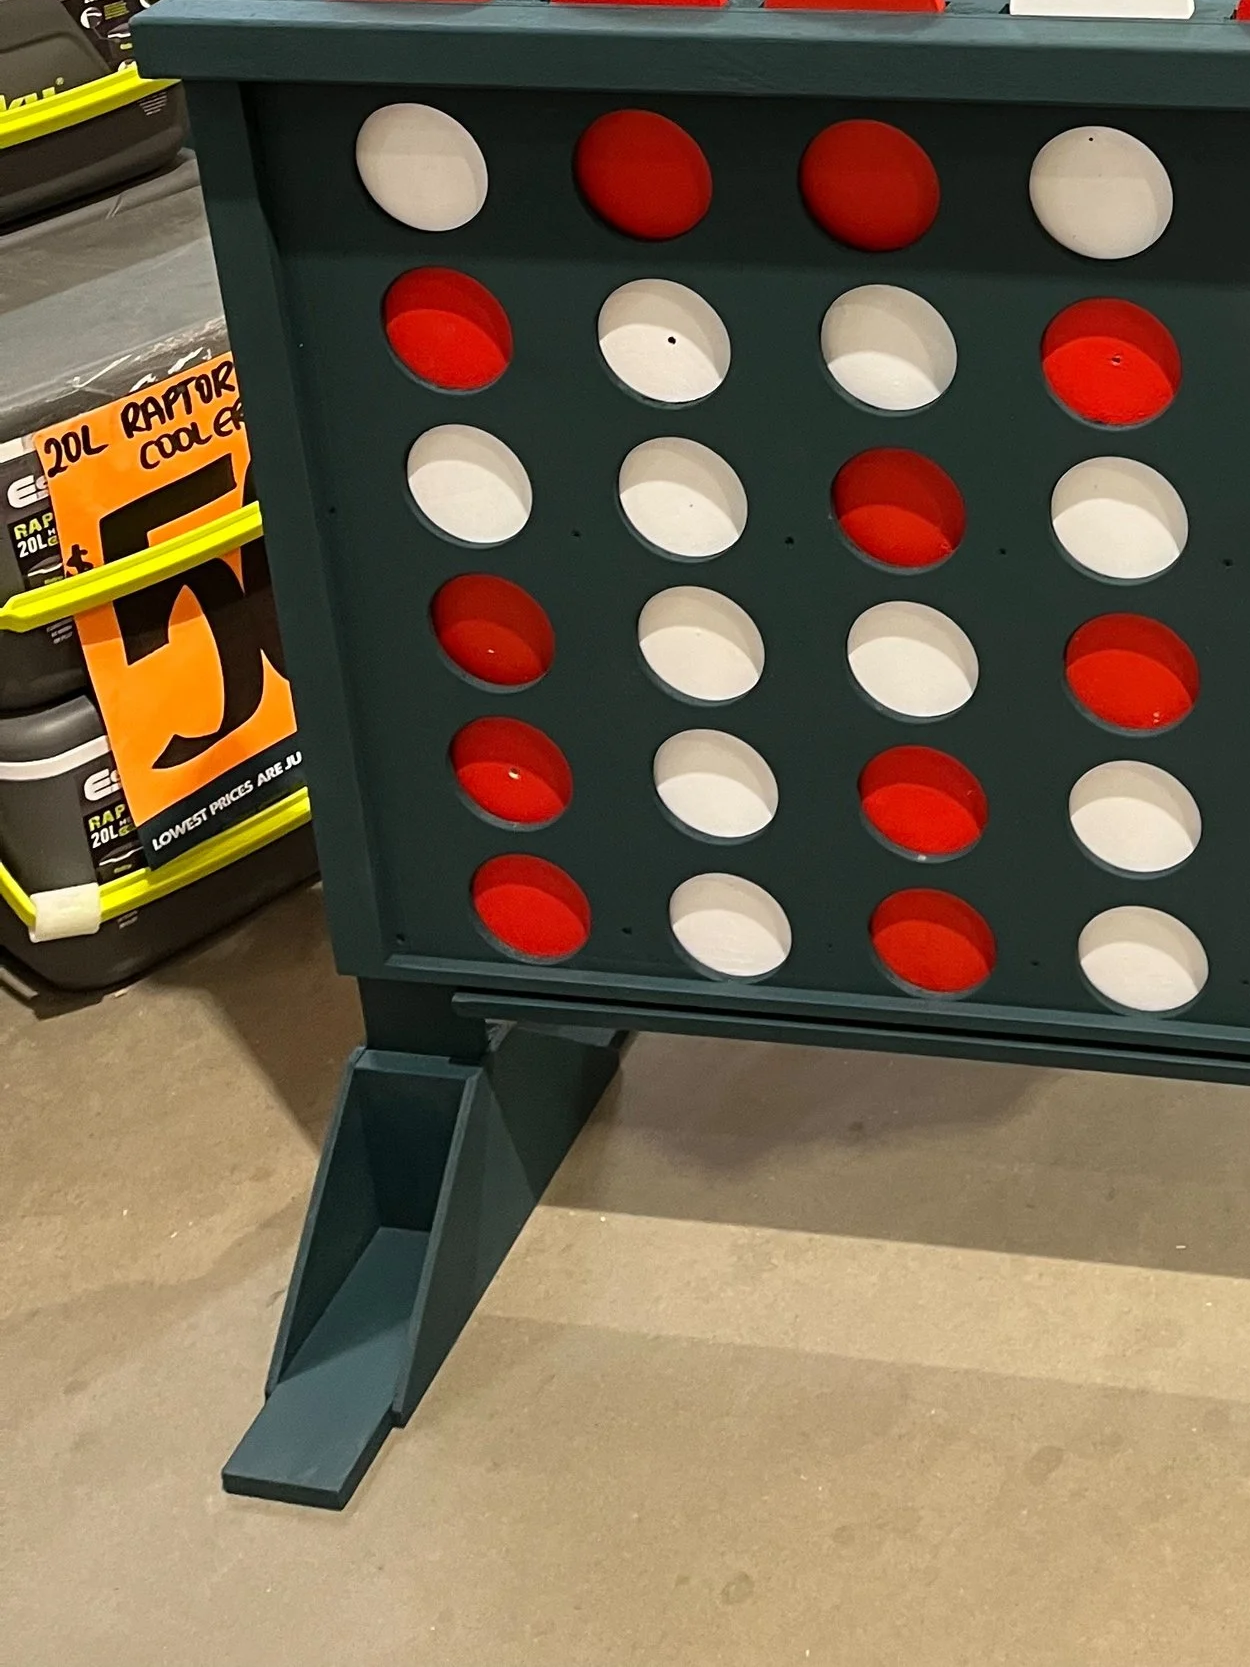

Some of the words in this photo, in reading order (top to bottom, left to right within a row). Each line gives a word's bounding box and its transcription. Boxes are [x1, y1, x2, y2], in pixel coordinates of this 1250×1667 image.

[44, 424, 109, 478] 20L
[120, 360, 236, 439] RAPTOR
[17, 535, 48, 559] 20L
[91, 823, 119, 850] 20L
[152, 807, 208, 852] LOWEST
[209, 780, 254, 816] PRICES
[257, 763, 284, 788] ARE
